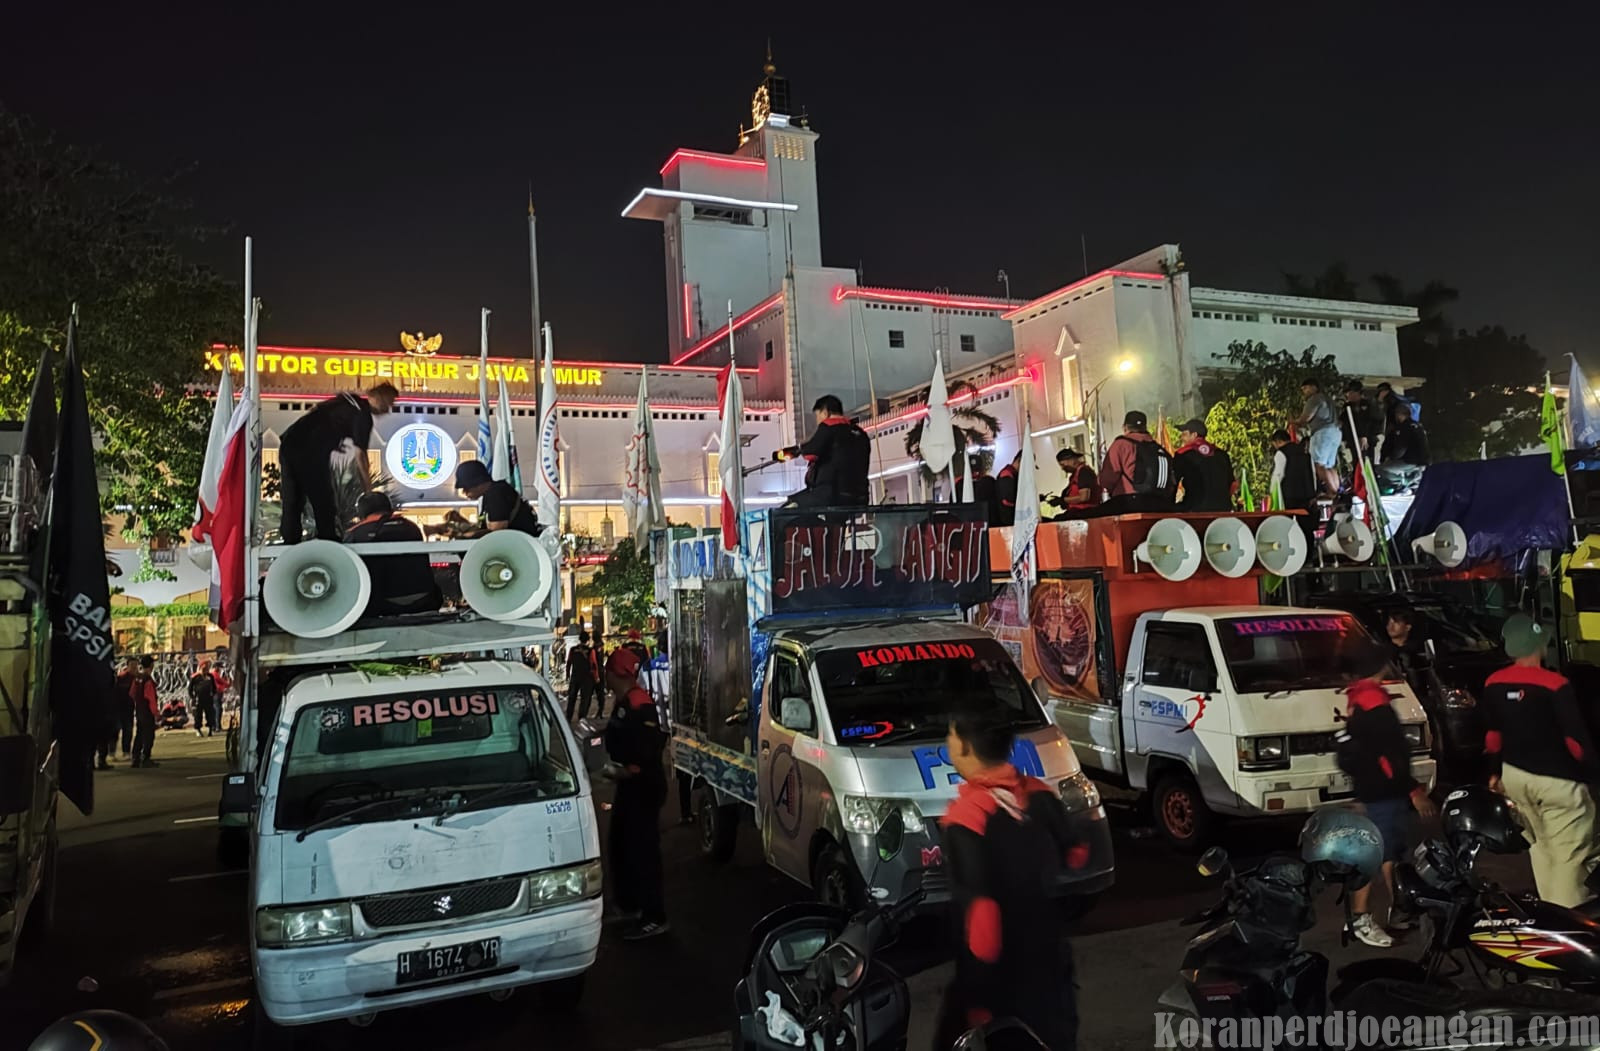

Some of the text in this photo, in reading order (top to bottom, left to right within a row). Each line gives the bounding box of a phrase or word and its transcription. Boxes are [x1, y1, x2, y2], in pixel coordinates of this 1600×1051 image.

[324, 358, 459, 380] GUBERNUR
[65, 616, 113, 661] SPSI
[1234, 617, 1349, 635] RESOLUSI
[857, 643, 976, 668] KOMANDO
[353, 694, 497, 727] RESOLUSI
[401, 939, 499, 974] H 1674 YR
